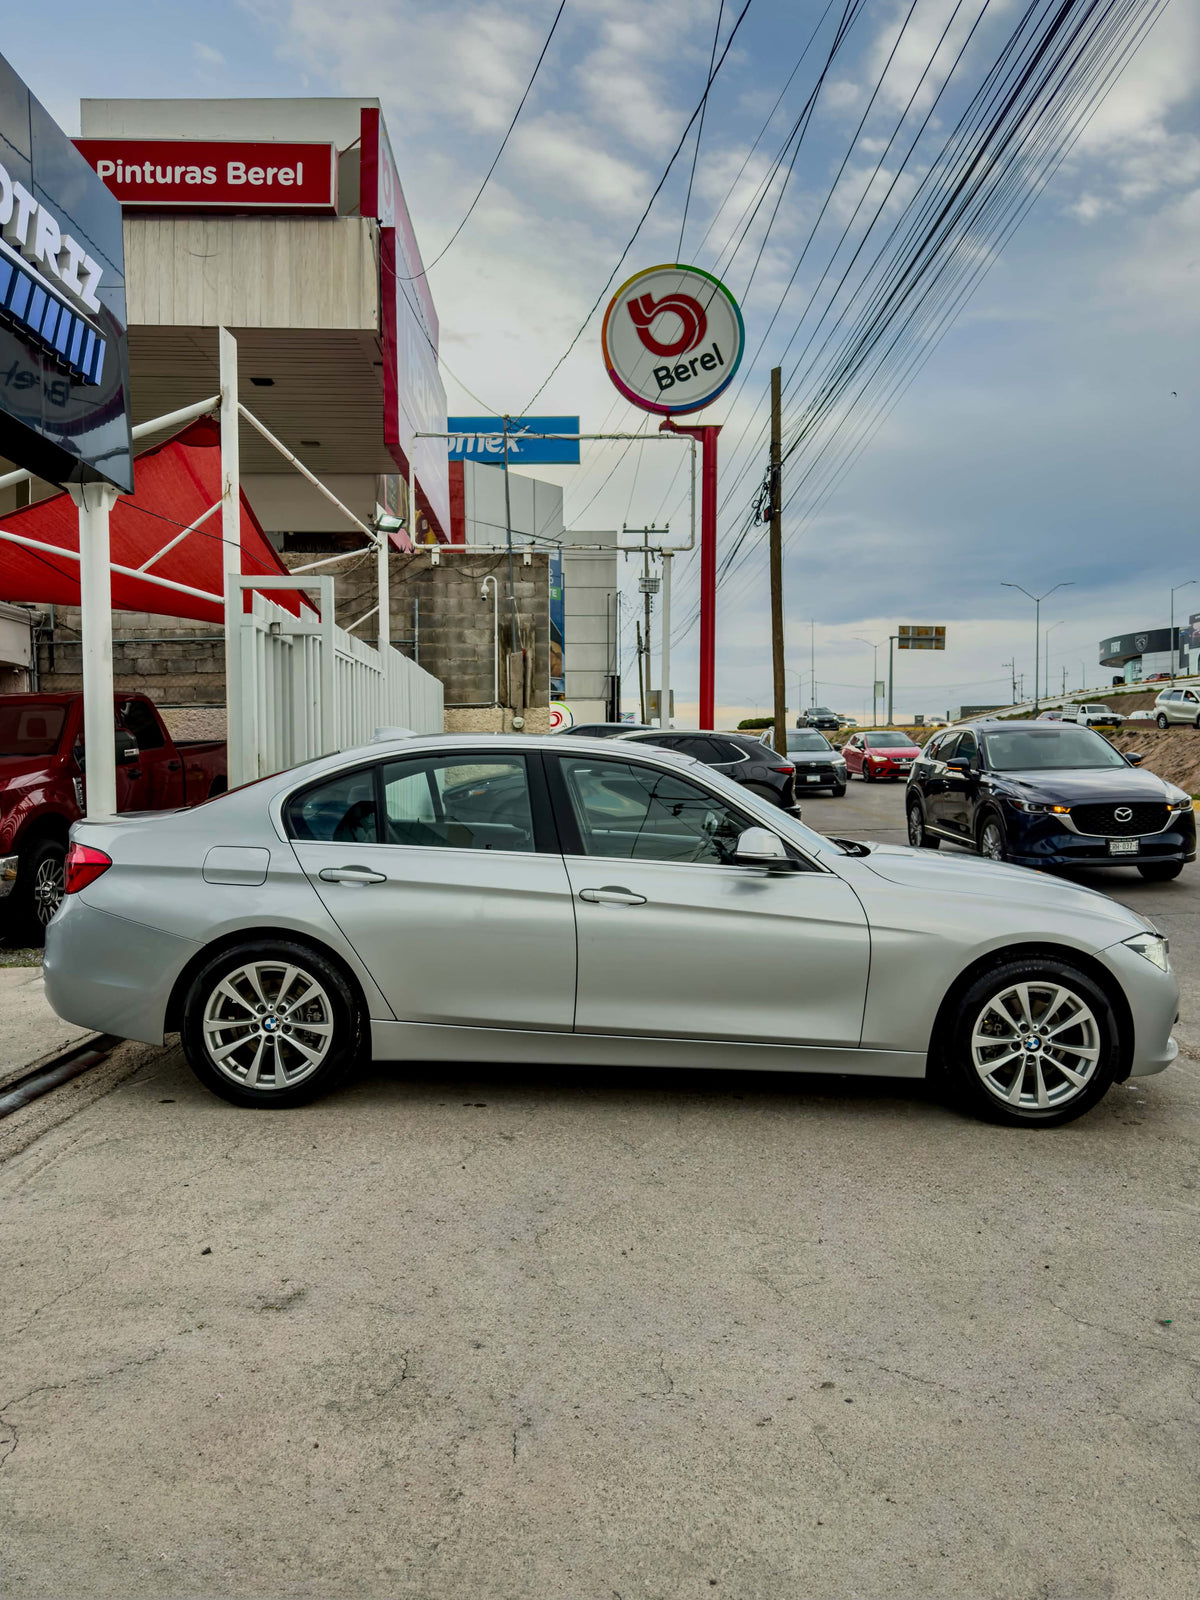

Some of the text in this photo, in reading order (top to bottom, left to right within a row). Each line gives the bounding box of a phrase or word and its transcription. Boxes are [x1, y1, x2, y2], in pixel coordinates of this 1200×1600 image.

[97, 159, 303, 186] Pinturas Berel
[653, 342, 724, 391] Berel
